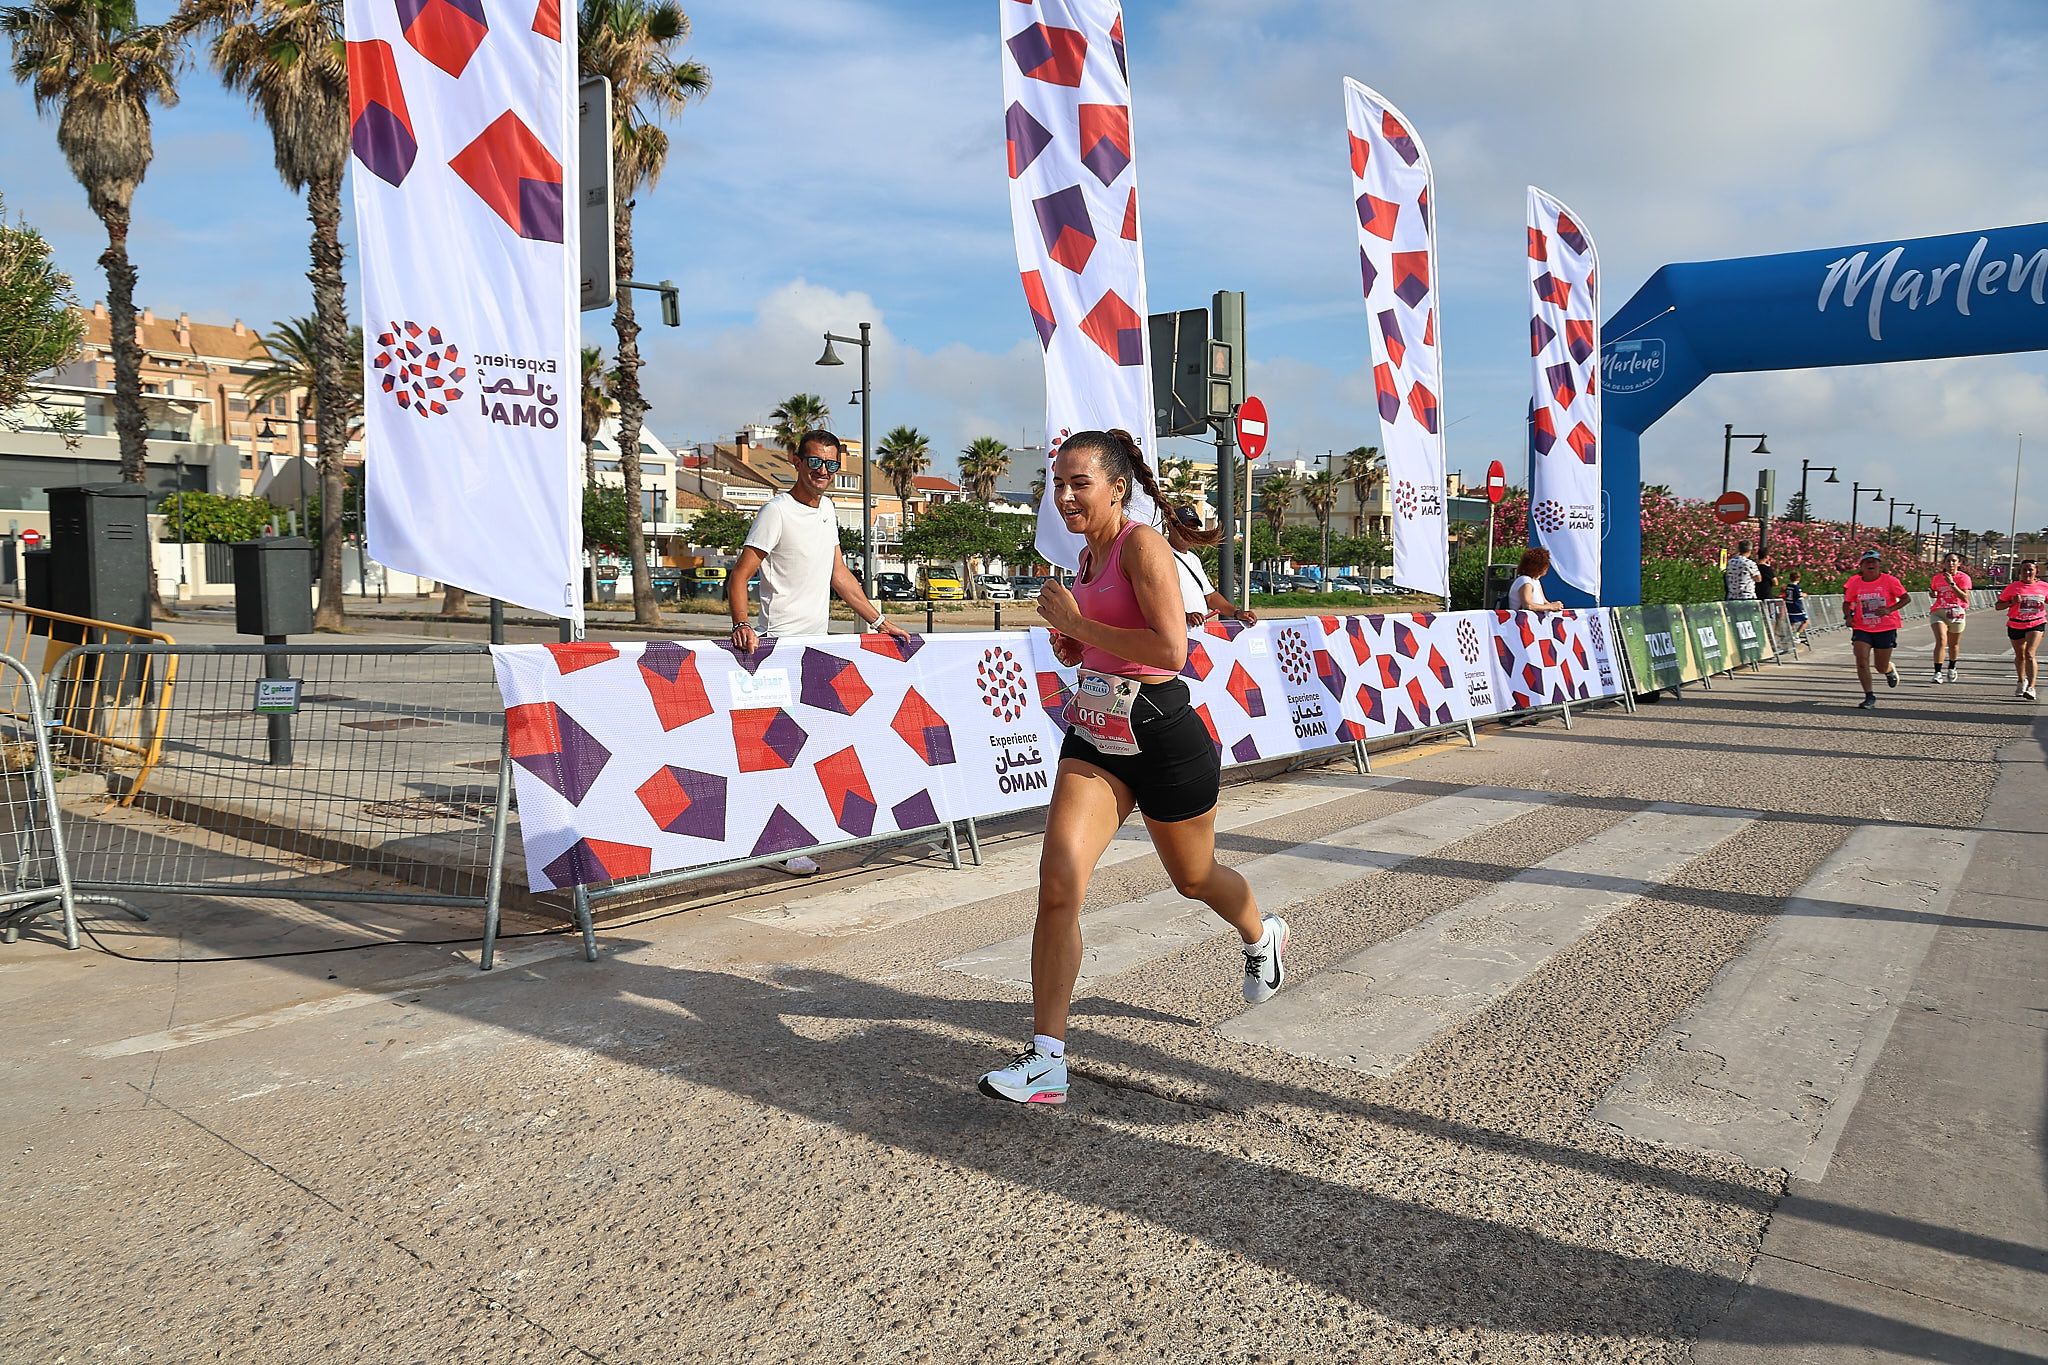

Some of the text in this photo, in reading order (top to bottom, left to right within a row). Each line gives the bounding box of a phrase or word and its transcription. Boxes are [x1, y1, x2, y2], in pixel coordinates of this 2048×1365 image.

[1817, 236, 2048, 341] Marlen
[1287, 692, 1320, 704] Experience
[1470, 694, 1492, 707] OMAN
[1294, 721, 1328, 739] OMAN
[990, 732, 1038, 748] Experience
[999, 770, 1048, 794] OMAN
